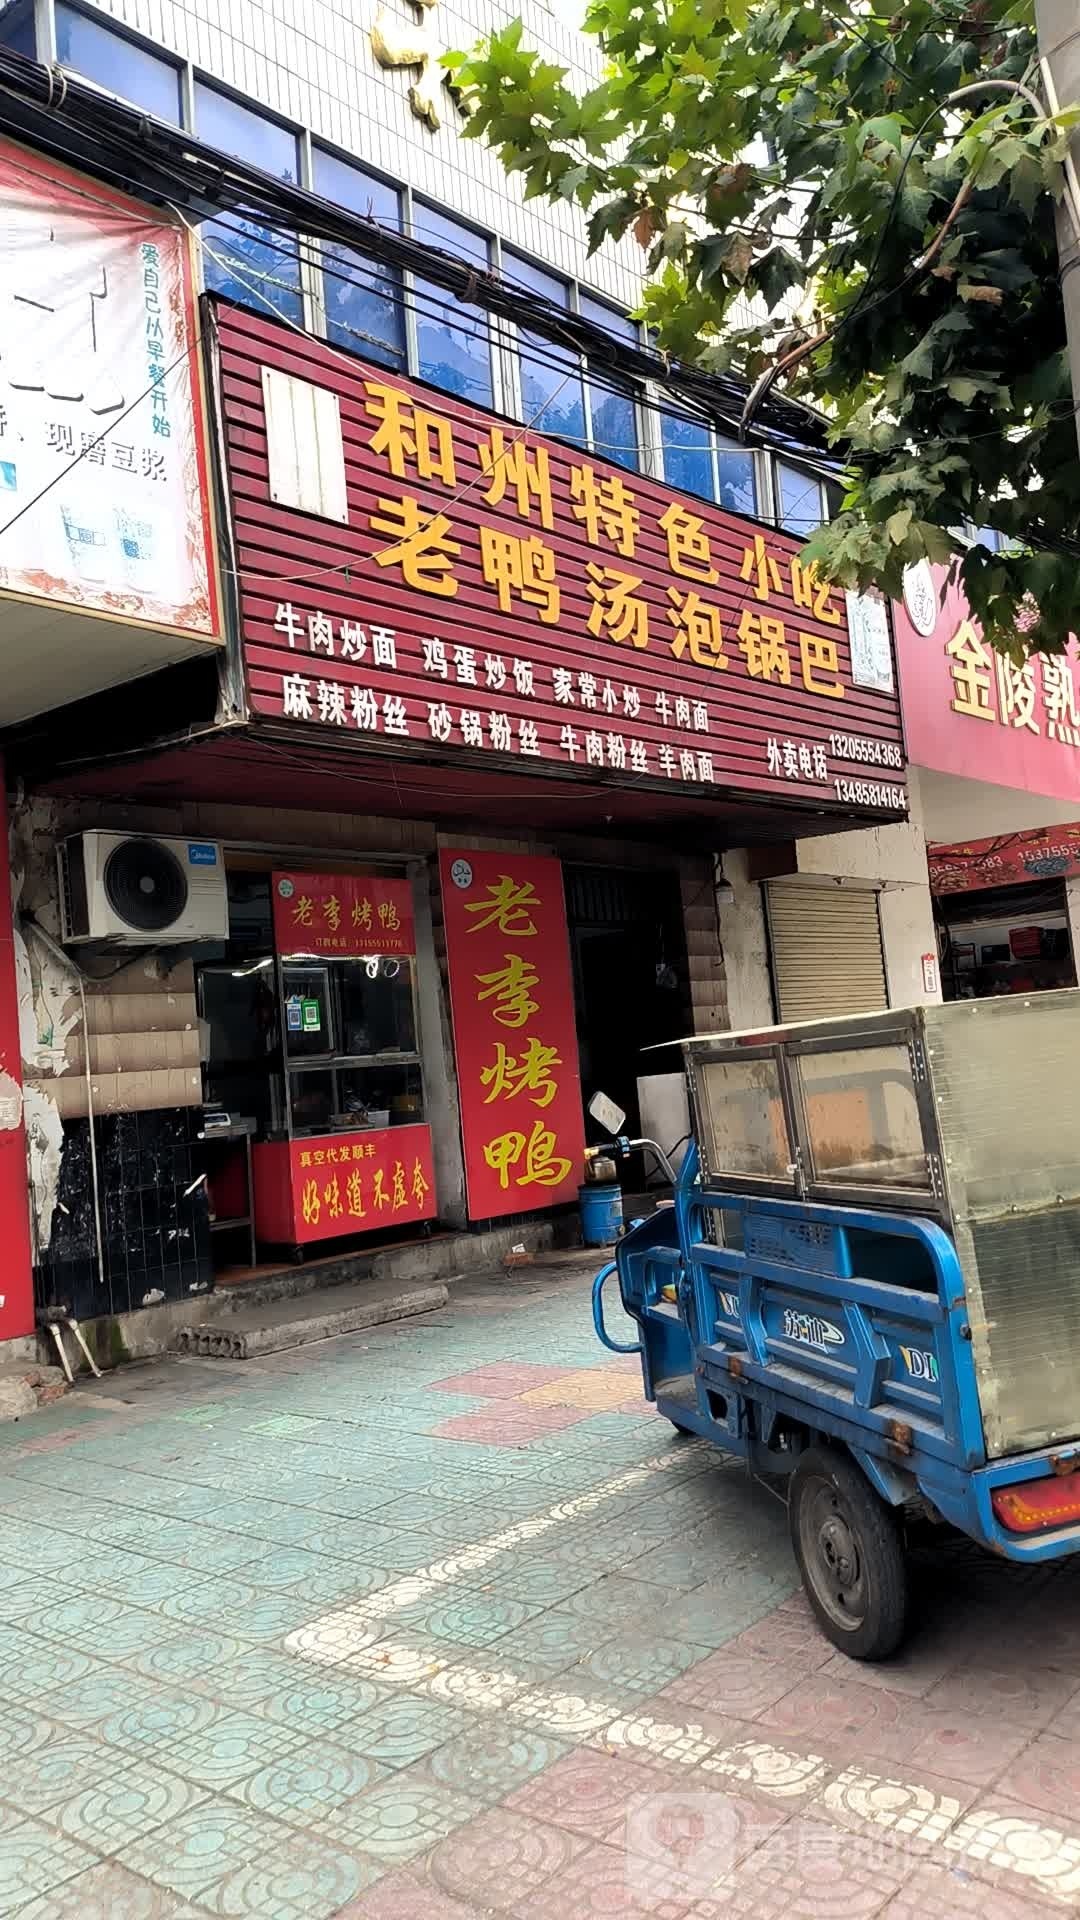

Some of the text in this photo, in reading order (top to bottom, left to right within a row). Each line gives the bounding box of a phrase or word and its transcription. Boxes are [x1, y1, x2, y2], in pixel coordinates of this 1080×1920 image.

[140, 242, 171, 438] 爱自己从早餐开始
[363, 382, 841, 625] 和州特色小吃
[368, 496, 845, 698] 老鸭汤泡锅巴
[274, 602, 711, 732] 牛肉炒面 鸡蛋炒饭 家常小炒 牛肉面
[282, 673, 716, 783] 麻辣粉丝 砂锅粉丝 牛肉粉丝 羊肉面
[766, 737, 828, 781] 外卖电话
[829, 733, 902, 768] 13205554368
[833, 779, 906, 811] 13485814164
[292, 895, 401, 932] 老李烤鸭
[463, 875, 573, 1190] 老李烤鸭
[299, 1144, 377, 1168] 真空代发顺丰
